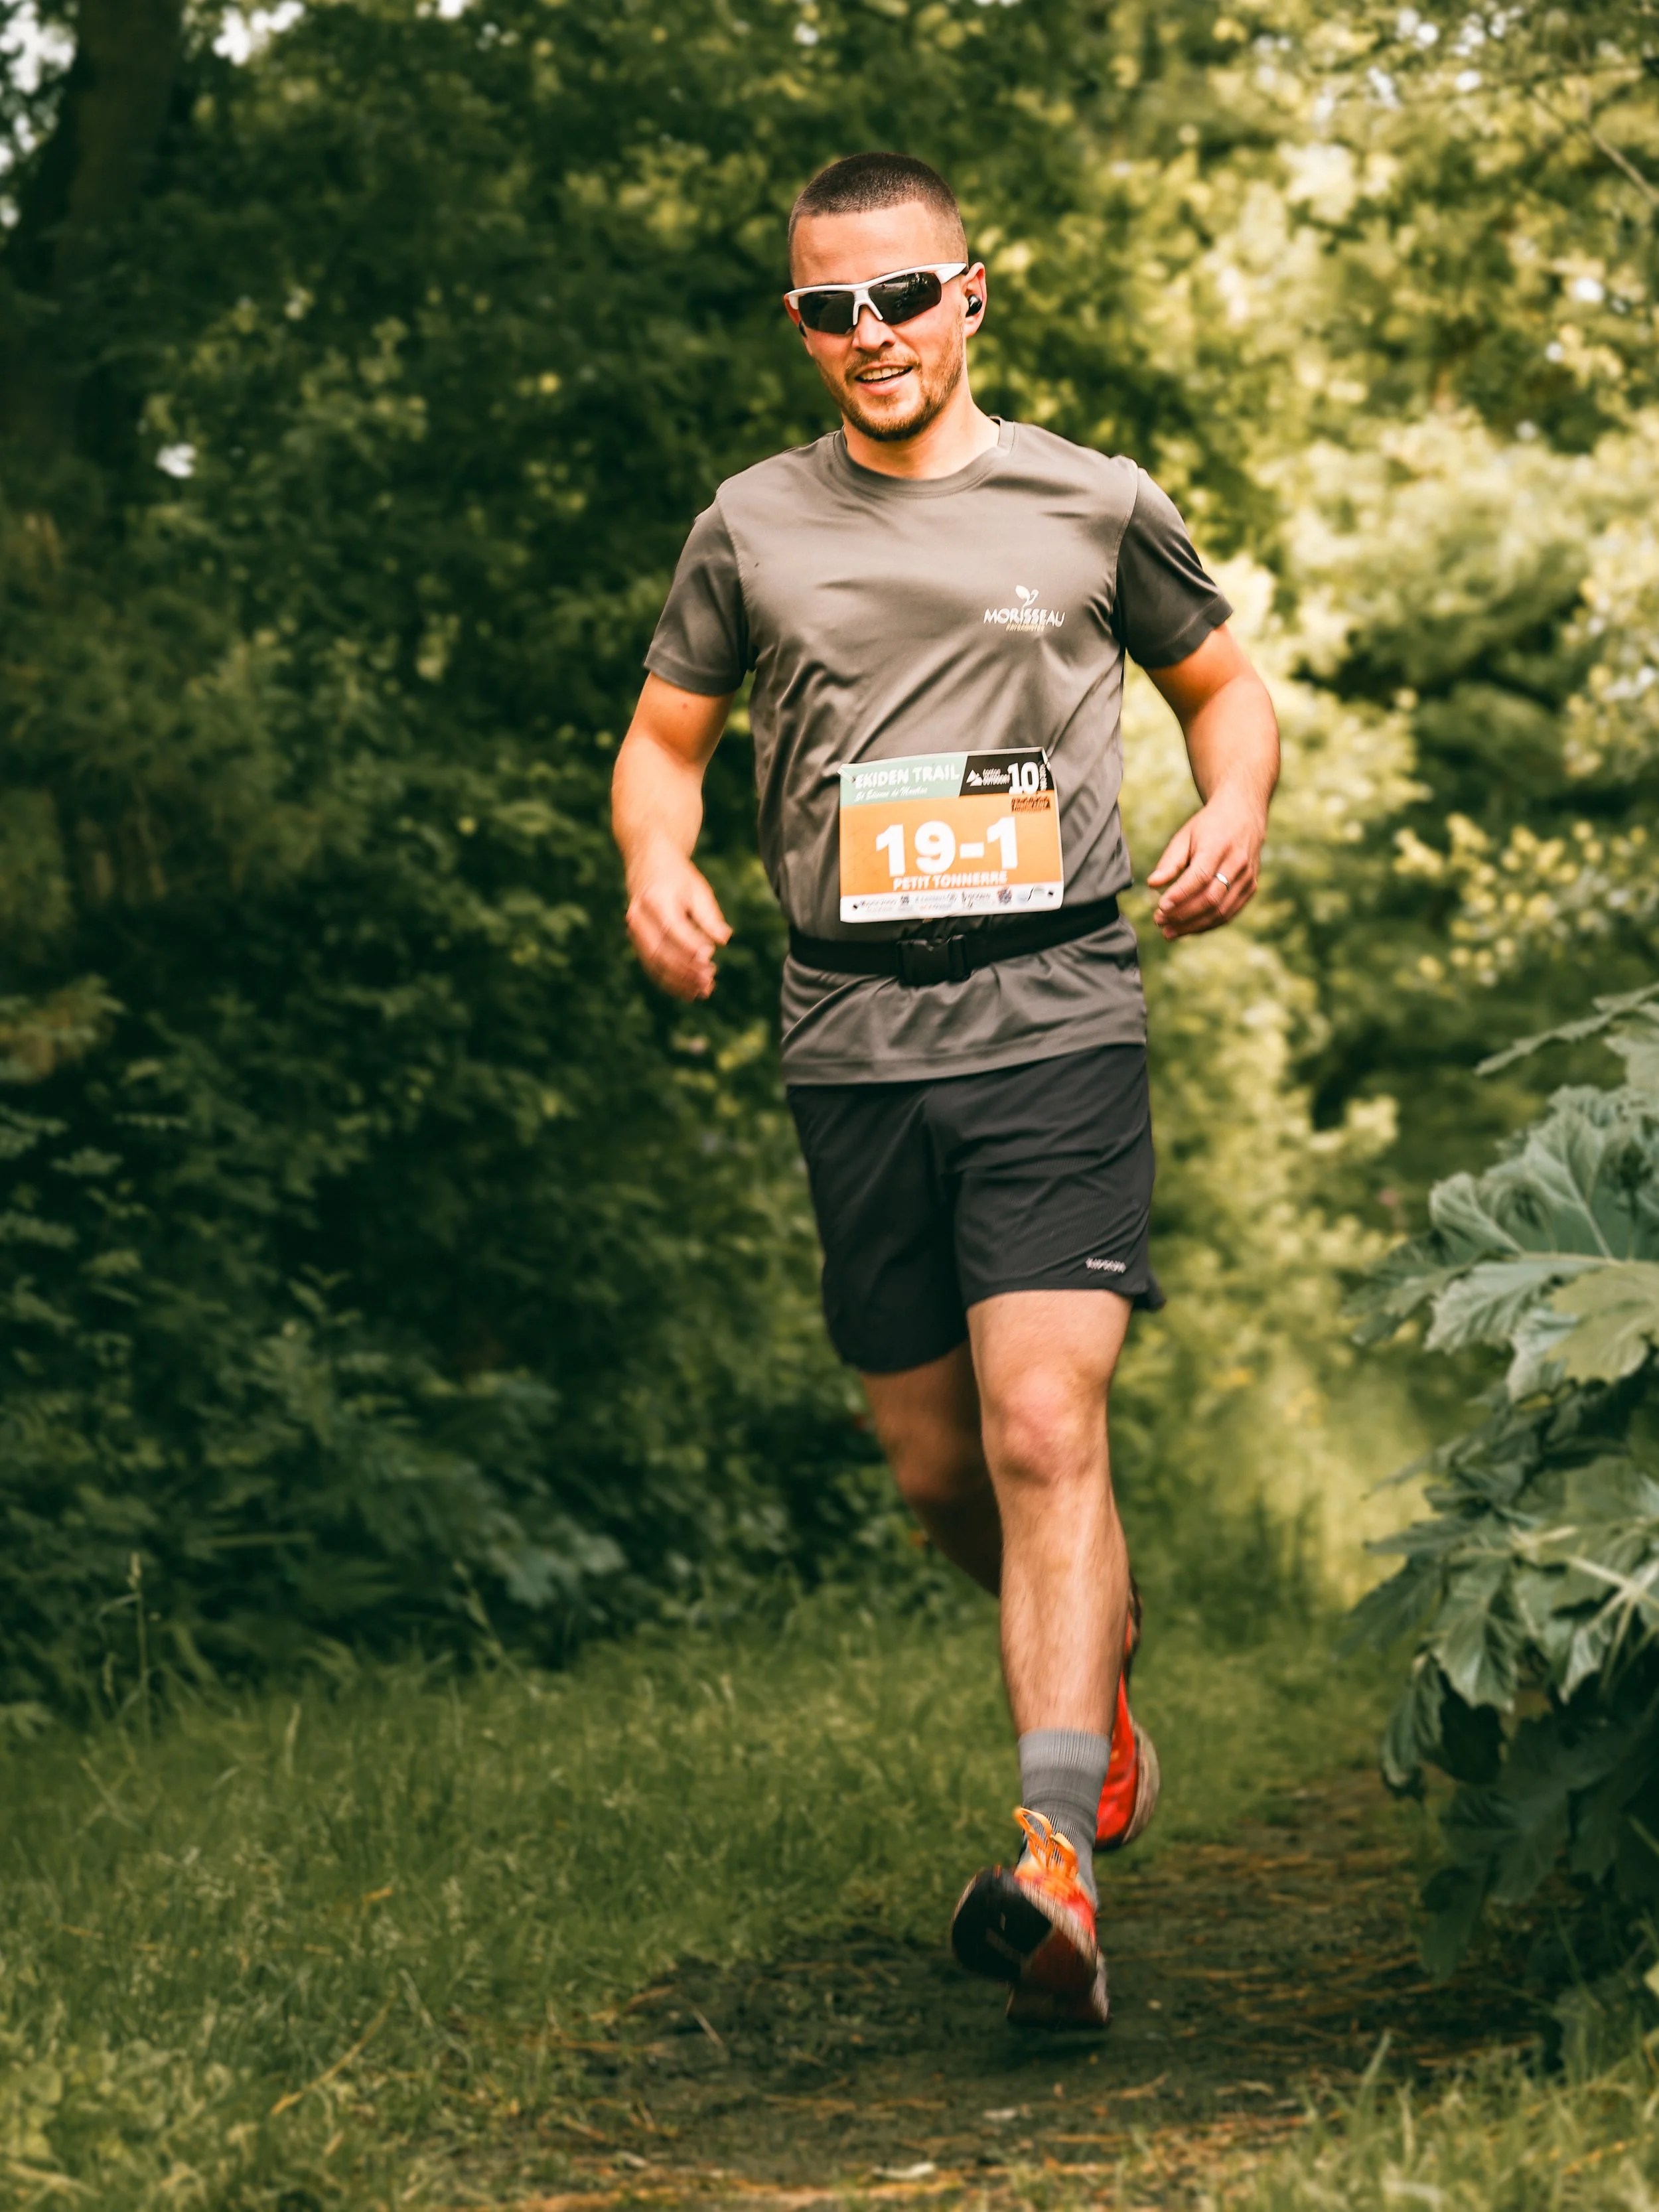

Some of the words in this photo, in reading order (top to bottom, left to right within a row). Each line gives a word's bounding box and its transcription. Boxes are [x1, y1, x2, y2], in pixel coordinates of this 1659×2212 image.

[983, 607, 1066, 627] MORISSEAU
[855, 768, 909, 790] EKIDEN
[912, 763, 960, 782] TRAIL
[1007, 761, 1040, 795] 10
[876, 816, 1018, 877] 19-1
[893, 875, 931, 891] PETIT
[932, 870, 1008, 889] TONNERRE
